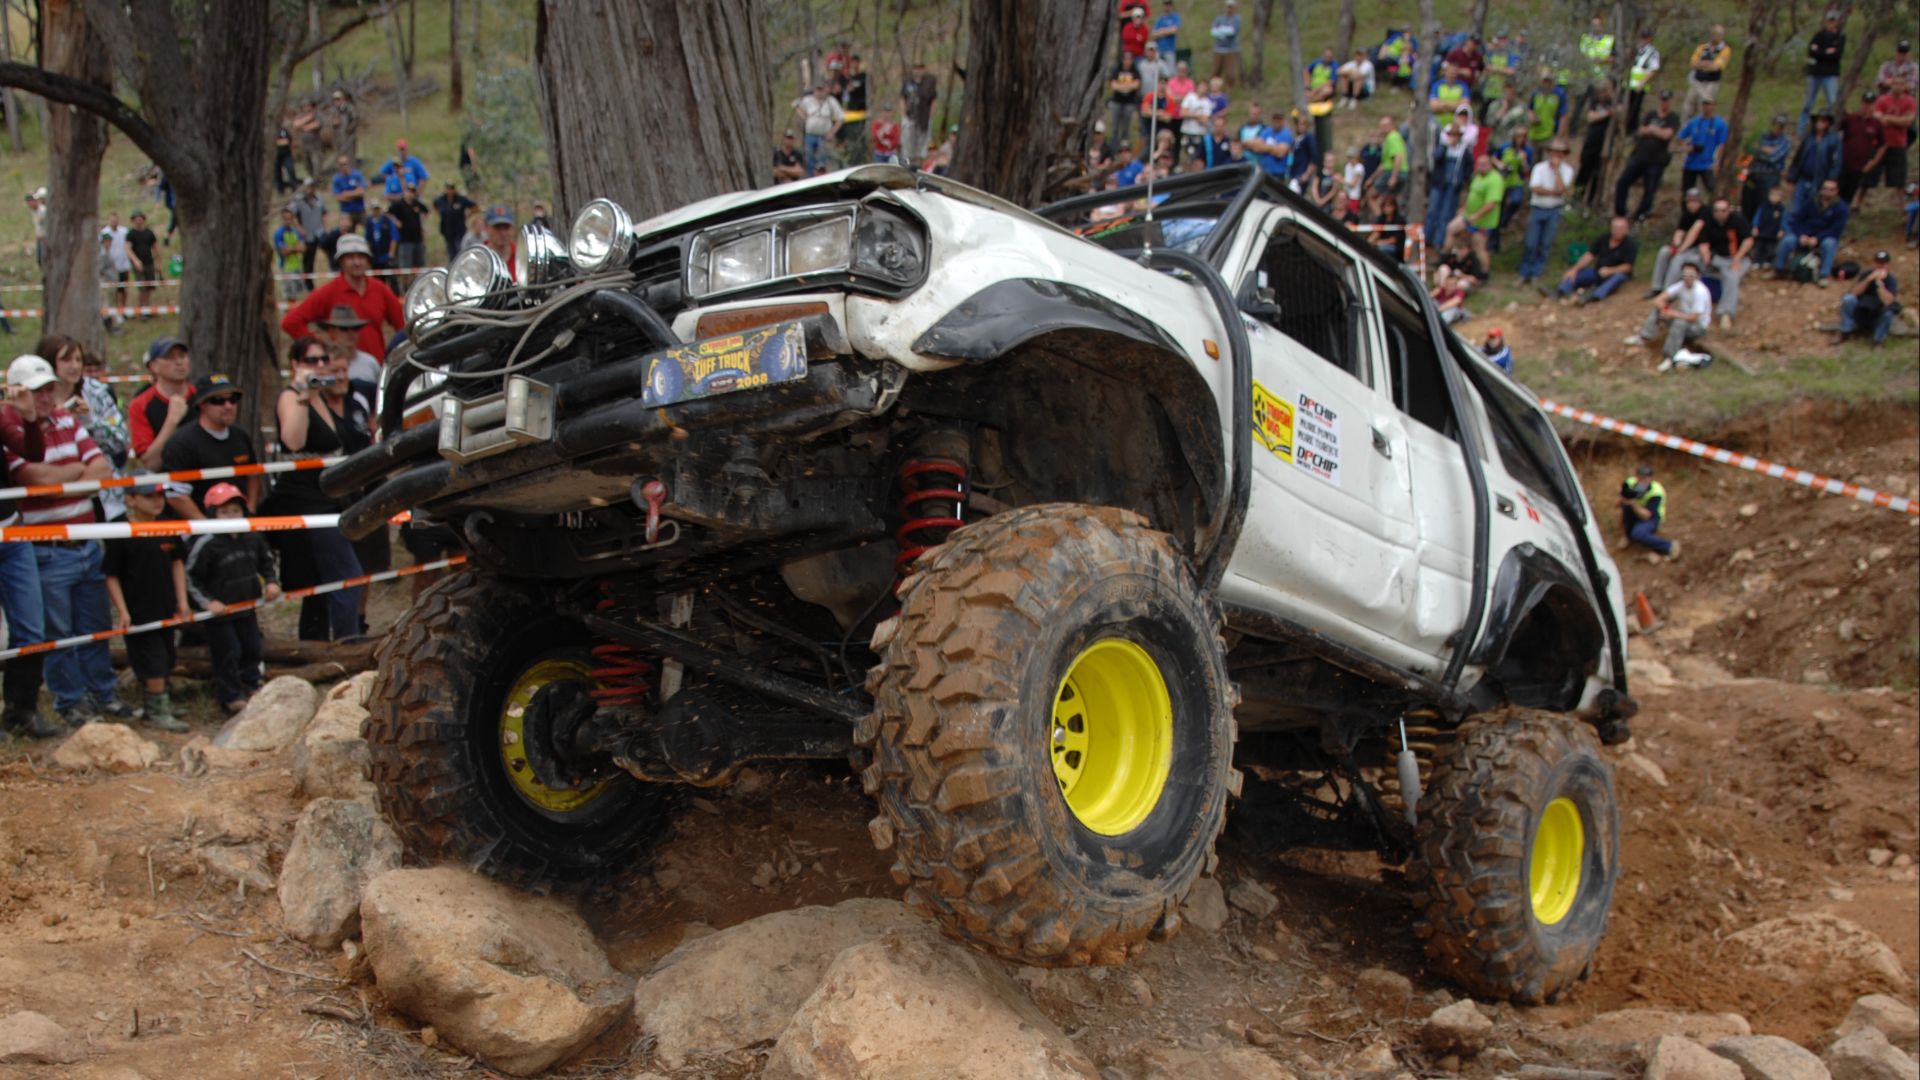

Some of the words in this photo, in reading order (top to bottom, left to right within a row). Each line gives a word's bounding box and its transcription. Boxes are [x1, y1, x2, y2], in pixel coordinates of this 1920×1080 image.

[694, 357, 716, 384] TUFF
[719, 349, 752, 375] TRUCK
[736, 372, 768, 390] 2008
[1317, 426, 1337, 444] POWER
